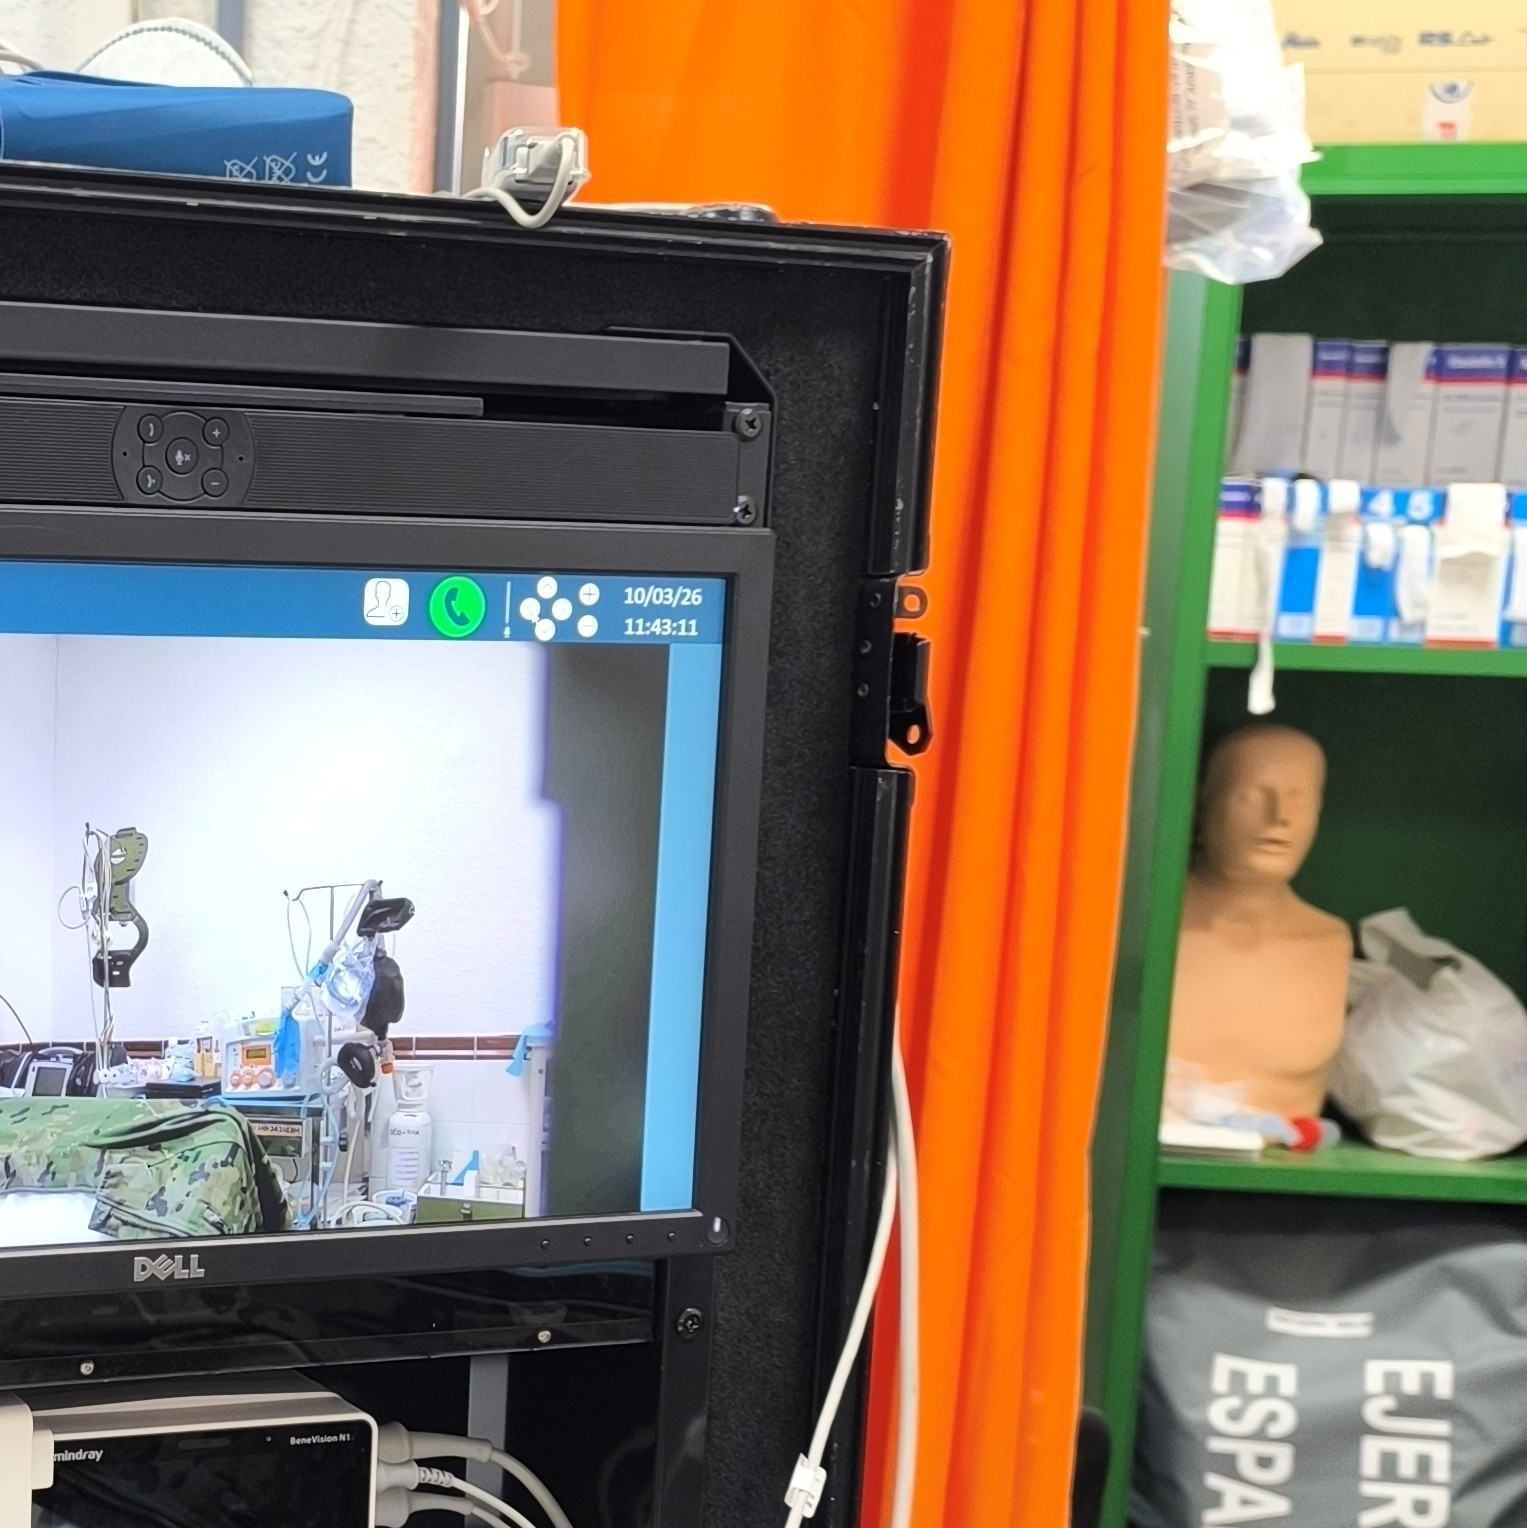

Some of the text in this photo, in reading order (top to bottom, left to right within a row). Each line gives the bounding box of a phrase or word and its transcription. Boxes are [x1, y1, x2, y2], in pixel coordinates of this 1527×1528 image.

[623, 585, 703, 607] 10/03/26
[623, 618, 699, 636] 11:43:11
[133, 1253, 205, 1282] DELL
[289, 1433, 351, 1445] BeneVision N1
[53, 1447, 104, 1463] mindray
